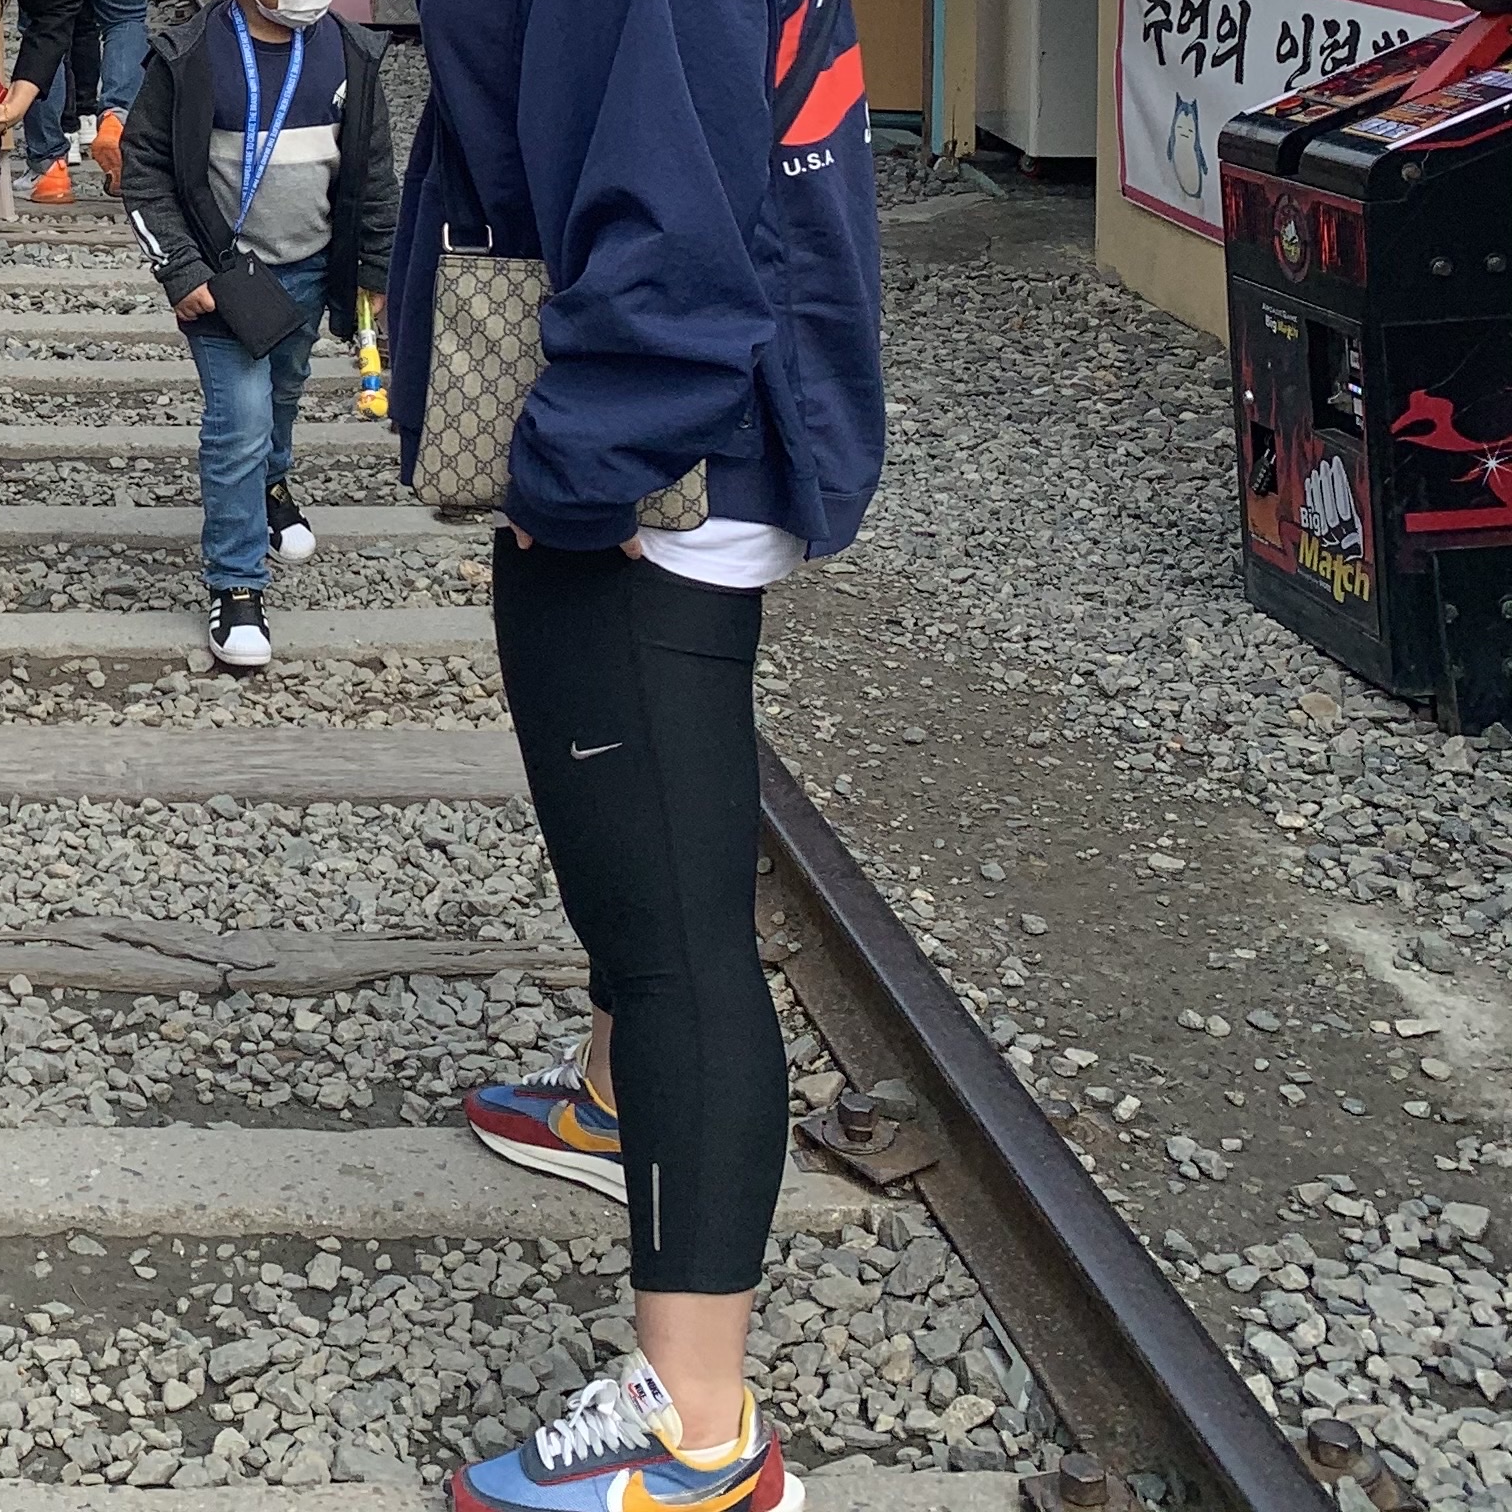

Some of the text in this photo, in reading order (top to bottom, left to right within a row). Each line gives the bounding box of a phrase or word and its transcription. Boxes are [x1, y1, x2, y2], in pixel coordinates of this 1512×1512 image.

[248, 111, 257, 122] THE
[246, 121, 256, 142] CREATE
[246, 141, 254, 150] TO
[1299, 507, 1321, 537] Big
[1299, 529, 1369, 604] Match
